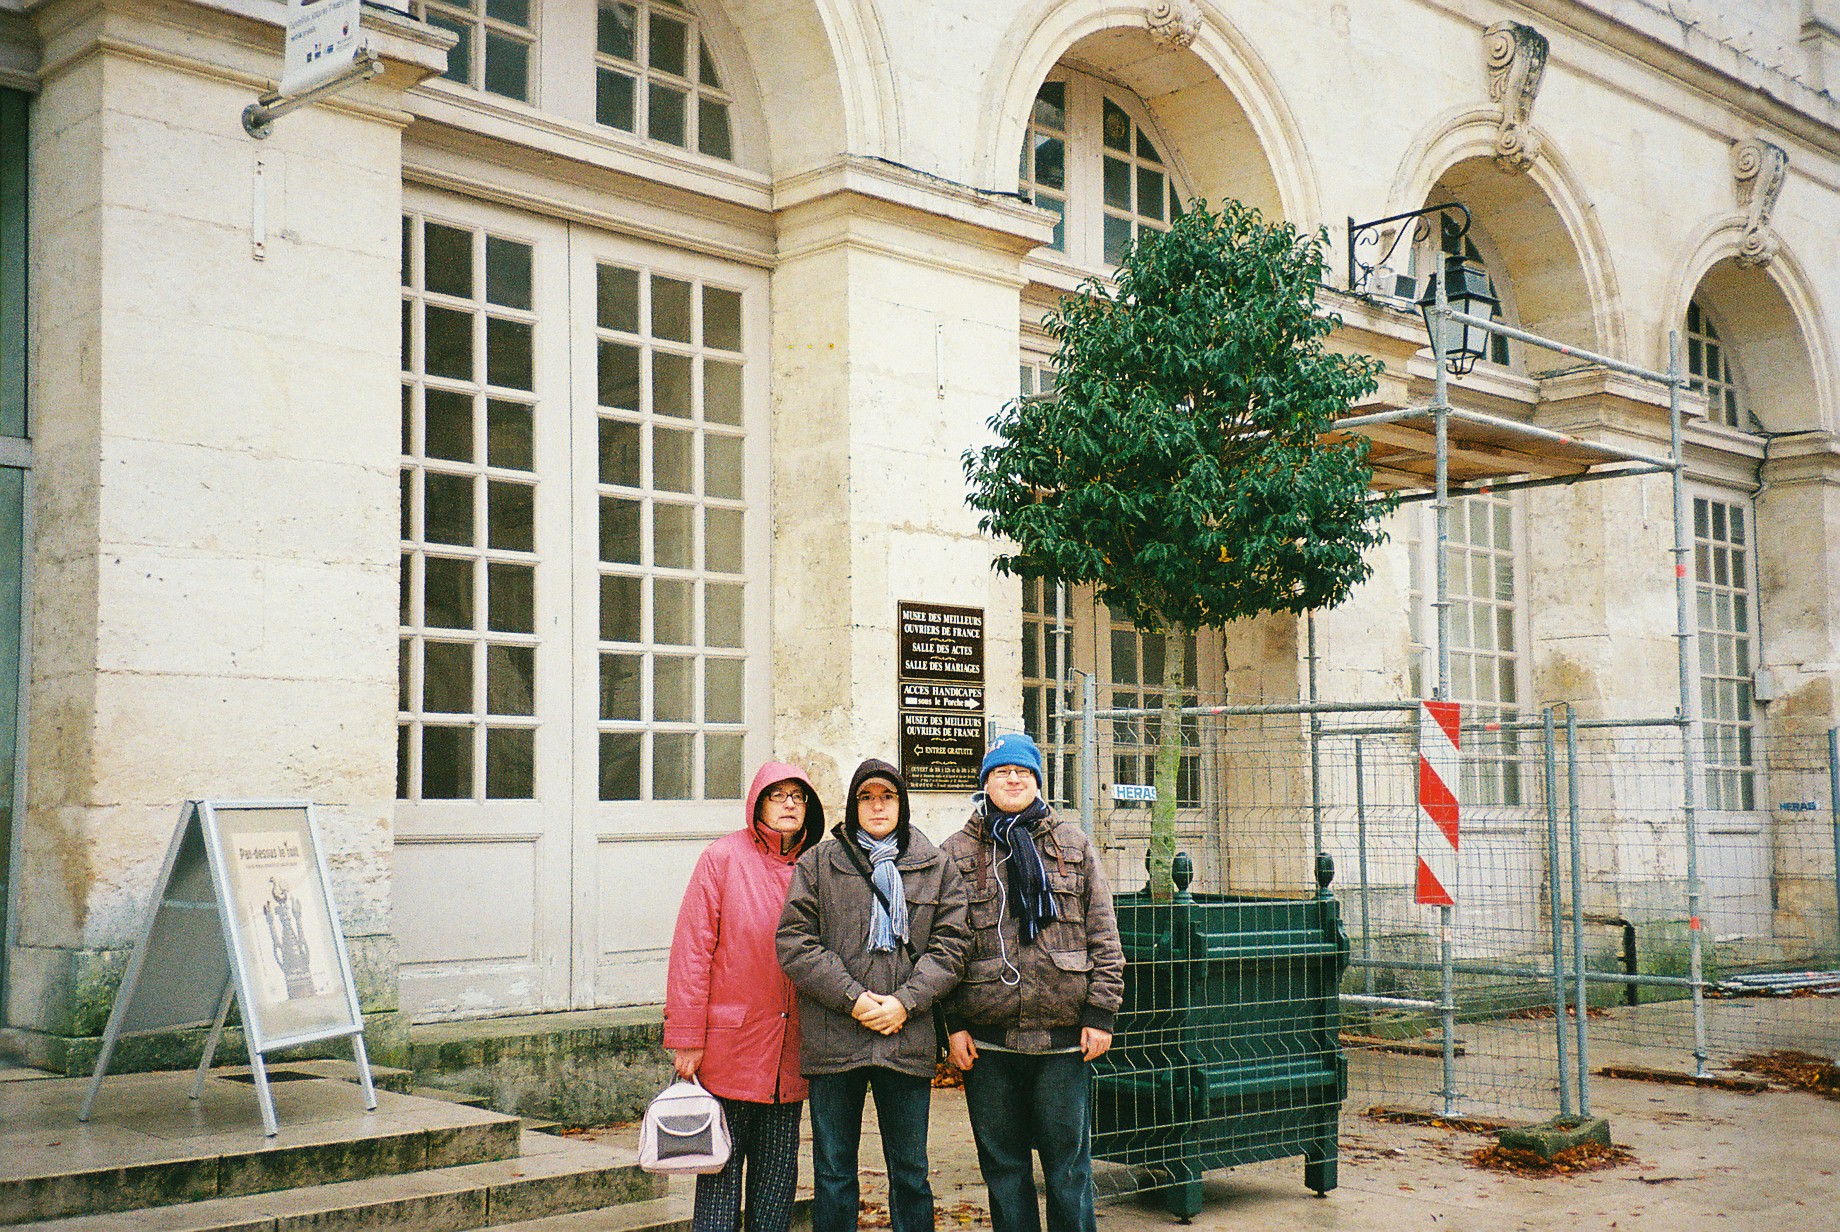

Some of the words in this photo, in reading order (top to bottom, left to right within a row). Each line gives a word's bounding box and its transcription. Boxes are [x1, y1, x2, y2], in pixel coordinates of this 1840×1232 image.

[903, 610, 927, 622] MUSEE
[928, 612, 942, 623] DES
[943, 613, 982, 626] MEILLEURS
[904, 623, 940, 635] OUVRIERS
[941, 626, 952, 636] DE
[953, 627, 981, 639] FRANCE
[912, 642, 935, 653] SALLE
[936, 644, 950, 654] DES
[951, 645, 973, 656] ACTES
[905, 659, 928, 670] SALLE
[929, 661, 943, 672] DES
[944, 662, 980, 674] MARIAGES
[904, 685, 930, 696] ACCES
[932, 686, 982, 698] HANDICAPES
[918, 698, 932, 706] sous
[934, 697, 941, 706] le
[943, 697, 965, 707] Porche
[905, 715, 928, 725] MUSEE
[930, 716, 943, 726] DES
[944, 717, 982, 728] MEILLEURS
[906, 725, 941, 736] OUVRIERS
[942, 727, 952, 737] DE
[953, 728, 980, 738] FRANCE
[925, 746, 947, 755] ENTREE
[947, 747, 973, 756] GRATUITE
